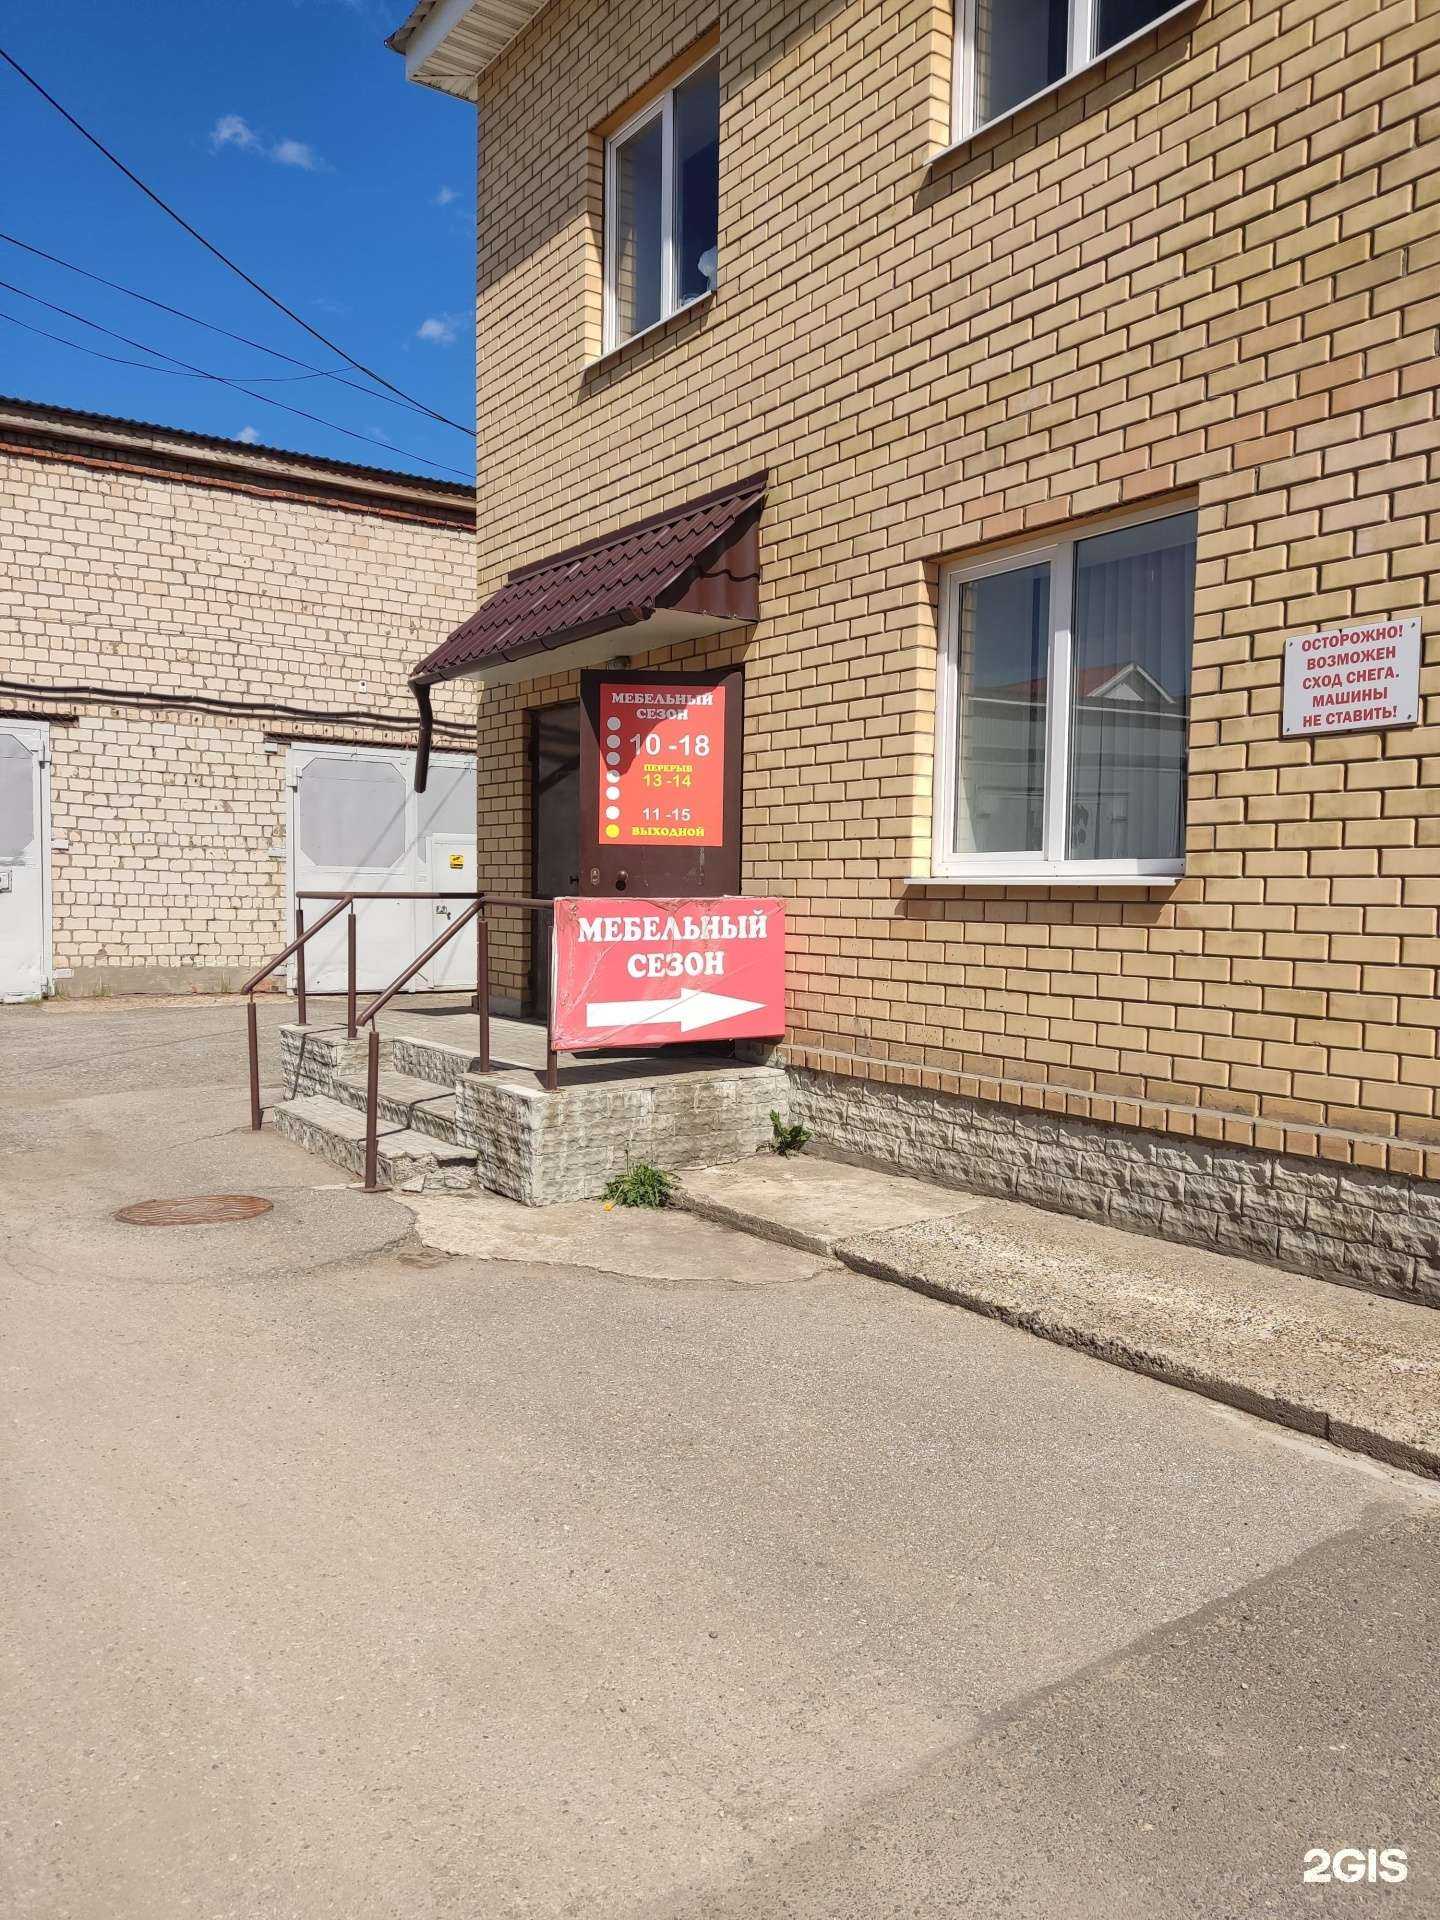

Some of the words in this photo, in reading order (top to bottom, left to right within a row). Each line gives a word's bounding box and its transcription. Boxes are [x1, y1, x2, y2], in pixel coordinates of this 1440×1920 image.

[1301, 625, 1404, 652] ОСТОРОЖНО!
[1307, 646, 1396, 670] ВОЗМОЖЕН
[1302, 674, 1343, 690] СХОД
[1346, 666, 1400, 684] СНЕГА.
[611, 692, 714, 706] МЕБЕЛЬНЫЙ
[1312, 687, 1388, 708] МАШИНЫ
[636, 708, 689, 720] СЕЗОН
[1303, 714, 1322, 728] НЕ
[1326, 706, 1398, 725] СТАВИТЬ!
[643, 764, 693, 773] ПЕРЕРЫВ
[631, 825, 705, 837] ВЫХОДНОЙ
[578, 909, 768, 942] МЕБЕЛЬНЫЙ
[627, 951, 725, 978] СЕЗОН
